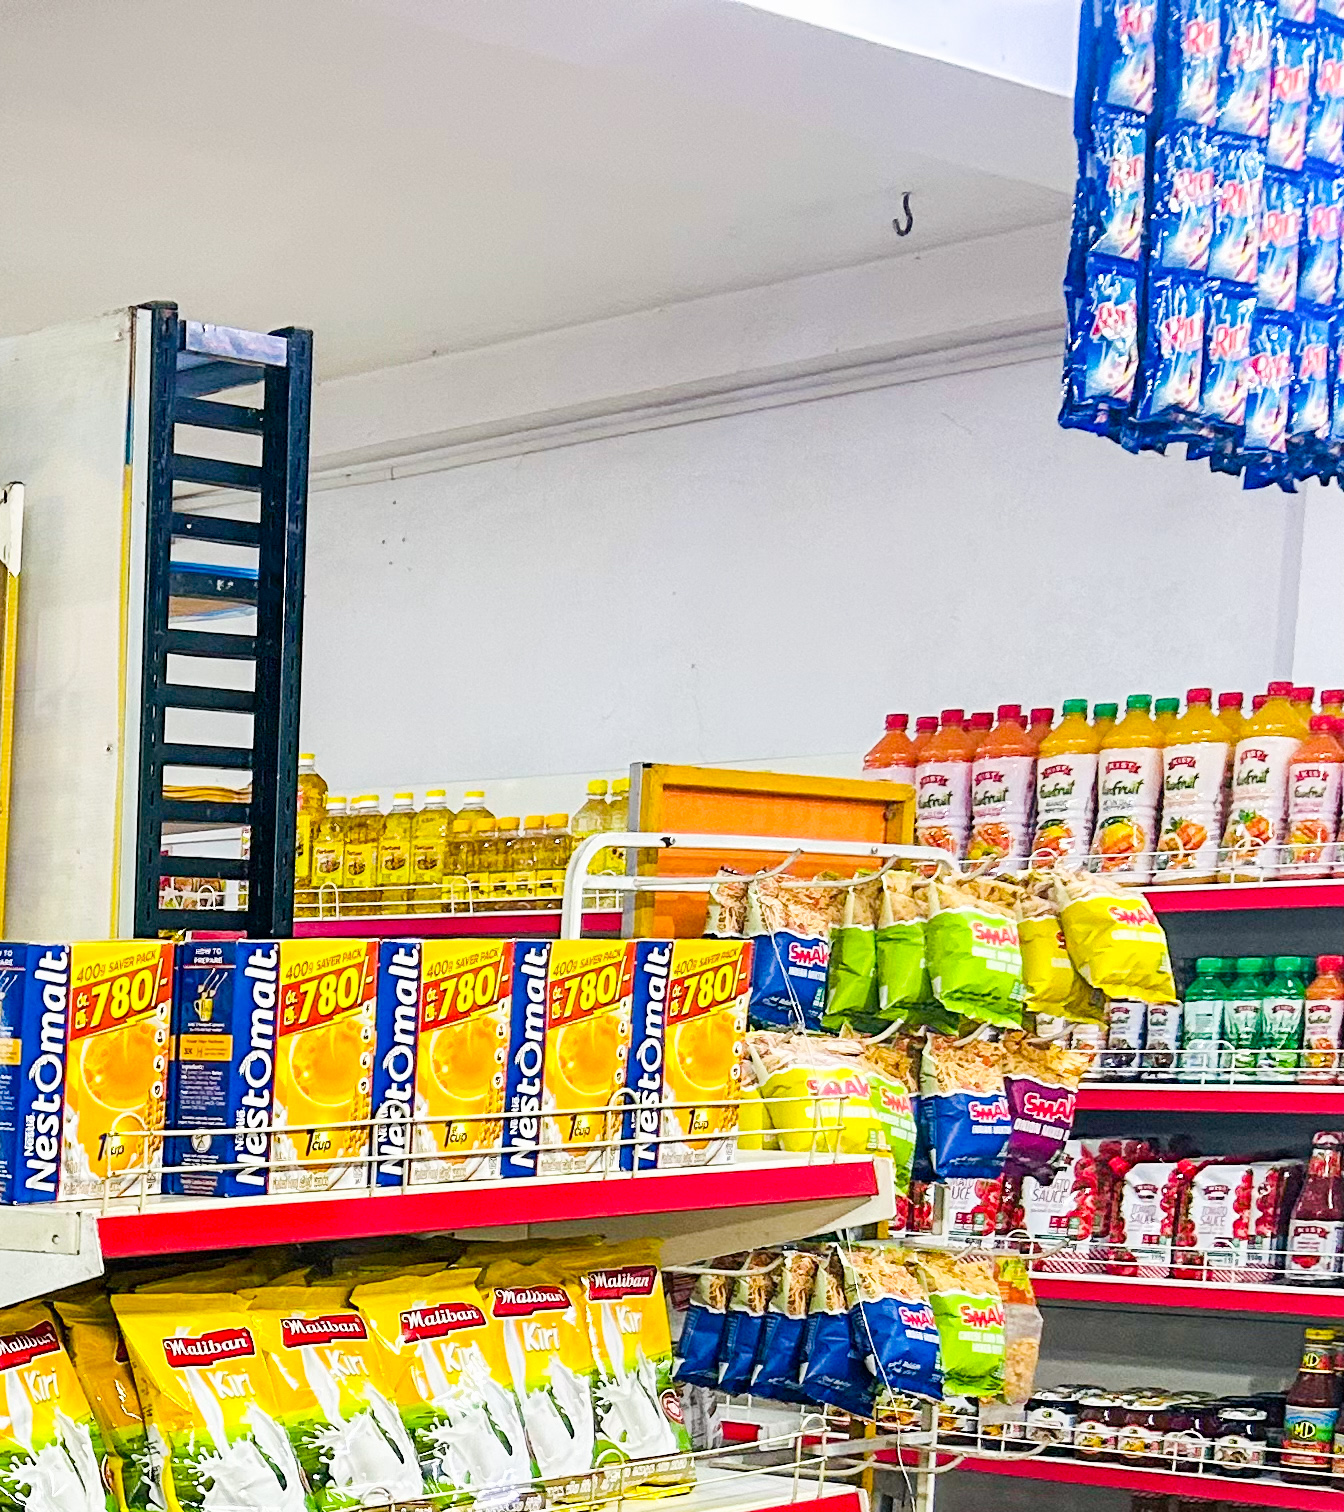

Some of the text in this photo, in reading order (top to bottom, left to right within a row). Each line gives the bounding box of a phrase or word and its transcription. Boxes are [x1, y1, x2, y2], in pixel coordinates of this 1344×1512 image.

[136, 949, 156, 966] PACK
[342, 948, 362, 963] PACK
[91, 957, 167, 1027] 780/-
[298, 956, 374, 1023] 780/-
[564, 955, 630, 1017] 780/-
[594, 1271, 652, 1292] Maliban
[287, 1317, 362, 1341] Maliban
[524, 1321, 558, 1354] Kiri
[171, 1337, 249, 1361] Maliban
[216, 1369, 254, 1401] Kiri
